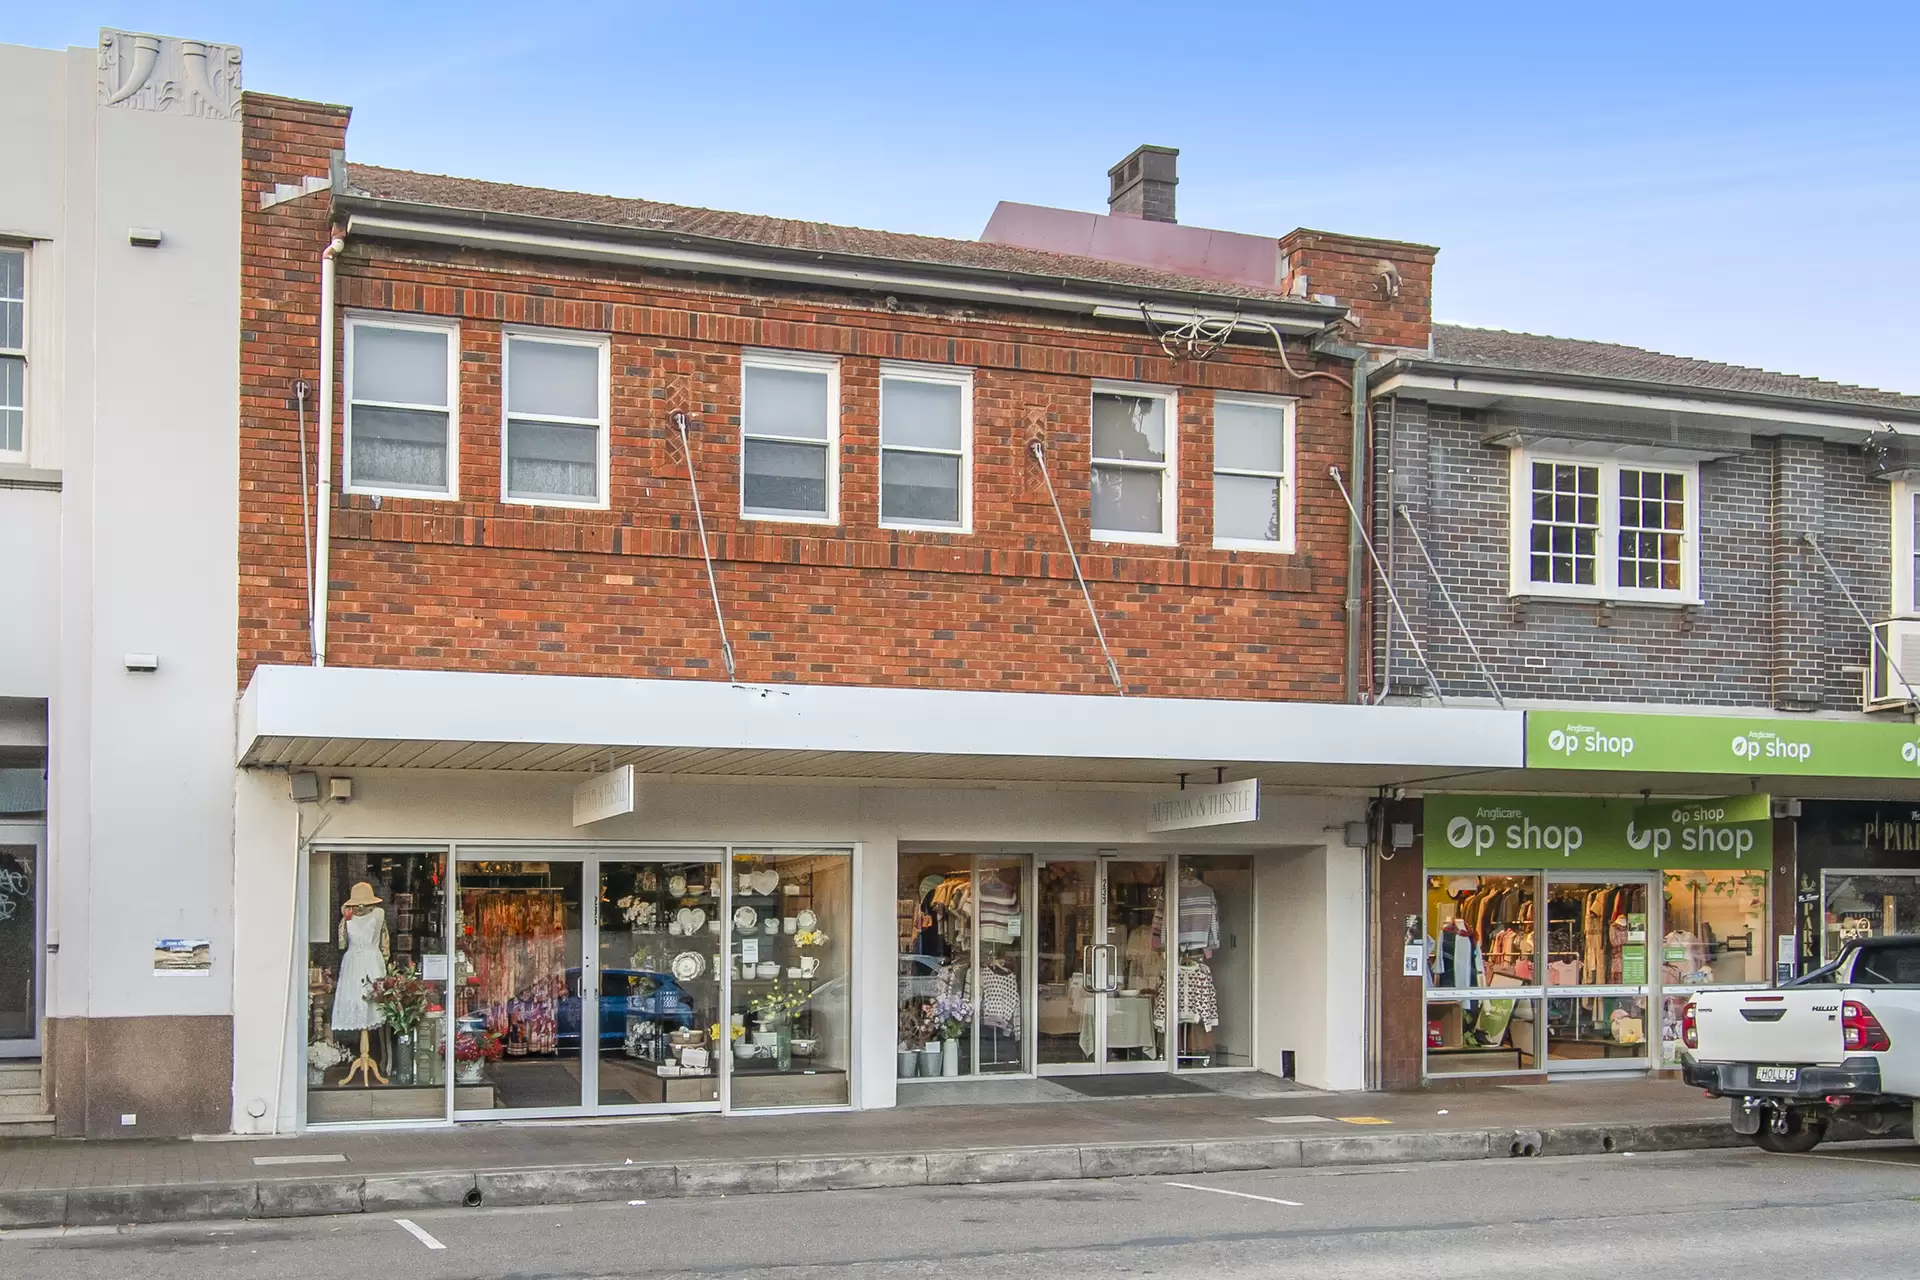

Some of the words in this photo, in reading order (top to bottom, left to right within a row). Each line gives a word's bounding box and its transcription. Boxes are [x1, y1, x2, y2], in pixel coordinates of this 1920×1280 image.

[1548, 729, 1579, 756] Op
[1585, 731, 1634, 757] shop
[1732, 736, 1760, 761] Op
[1766, 737, 1811, 762] shop
[1208, 790, 1251, 816] THISTLE
[1476, 807, 1523, 820] Anglicare
[1693, 807, 1725, 822] shop
[1447, 816, 1495, 856] Op
[1506, 817, 1583, 857] shop
[1681, 823, 1754, 859] shop
[1762, 1068, 1796, 1080] HOLLIS
